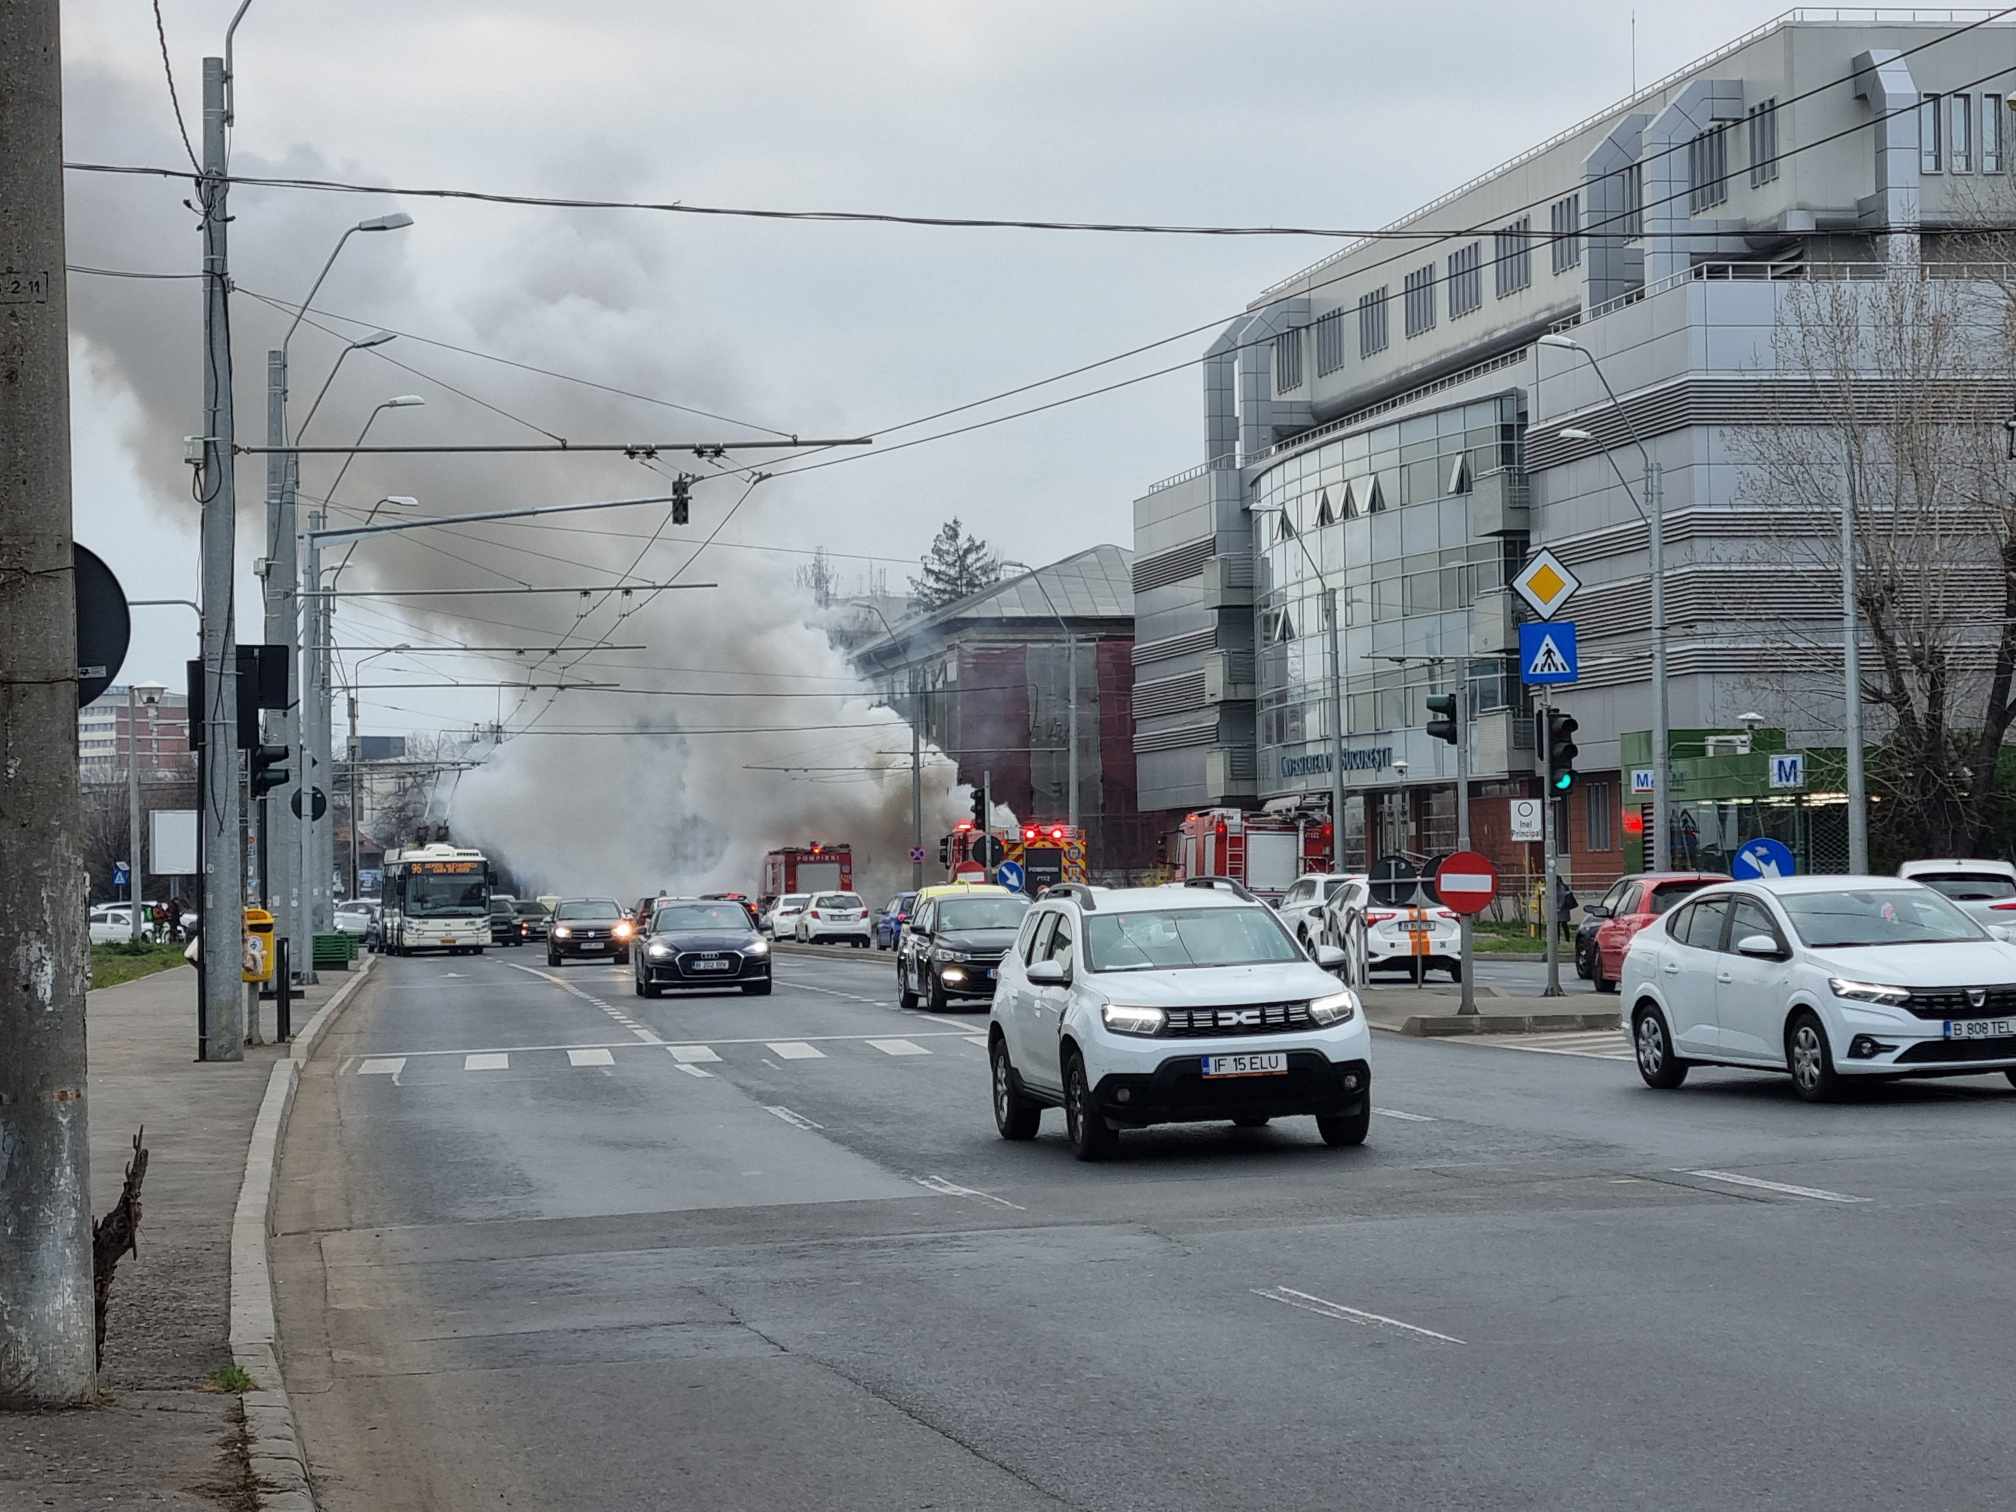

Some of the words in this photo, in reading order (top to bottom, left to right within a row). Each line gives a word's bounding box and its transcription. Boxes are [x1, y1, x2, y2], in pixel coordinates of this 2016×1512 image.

[0, 279, 40, 294] -2-11
[1777, 759, 1798, 783] M
[1953, 1023, 1963, 1036] B
[1967, 1022, 1989, 1035] 808
[1991, 1021, 2014, 1034] TEL
[1214, 1058, 1228, 1073] IF
[1233, 1057, 1247, 1071] 15
[1249, 1055, 1279, 1071] ELU
